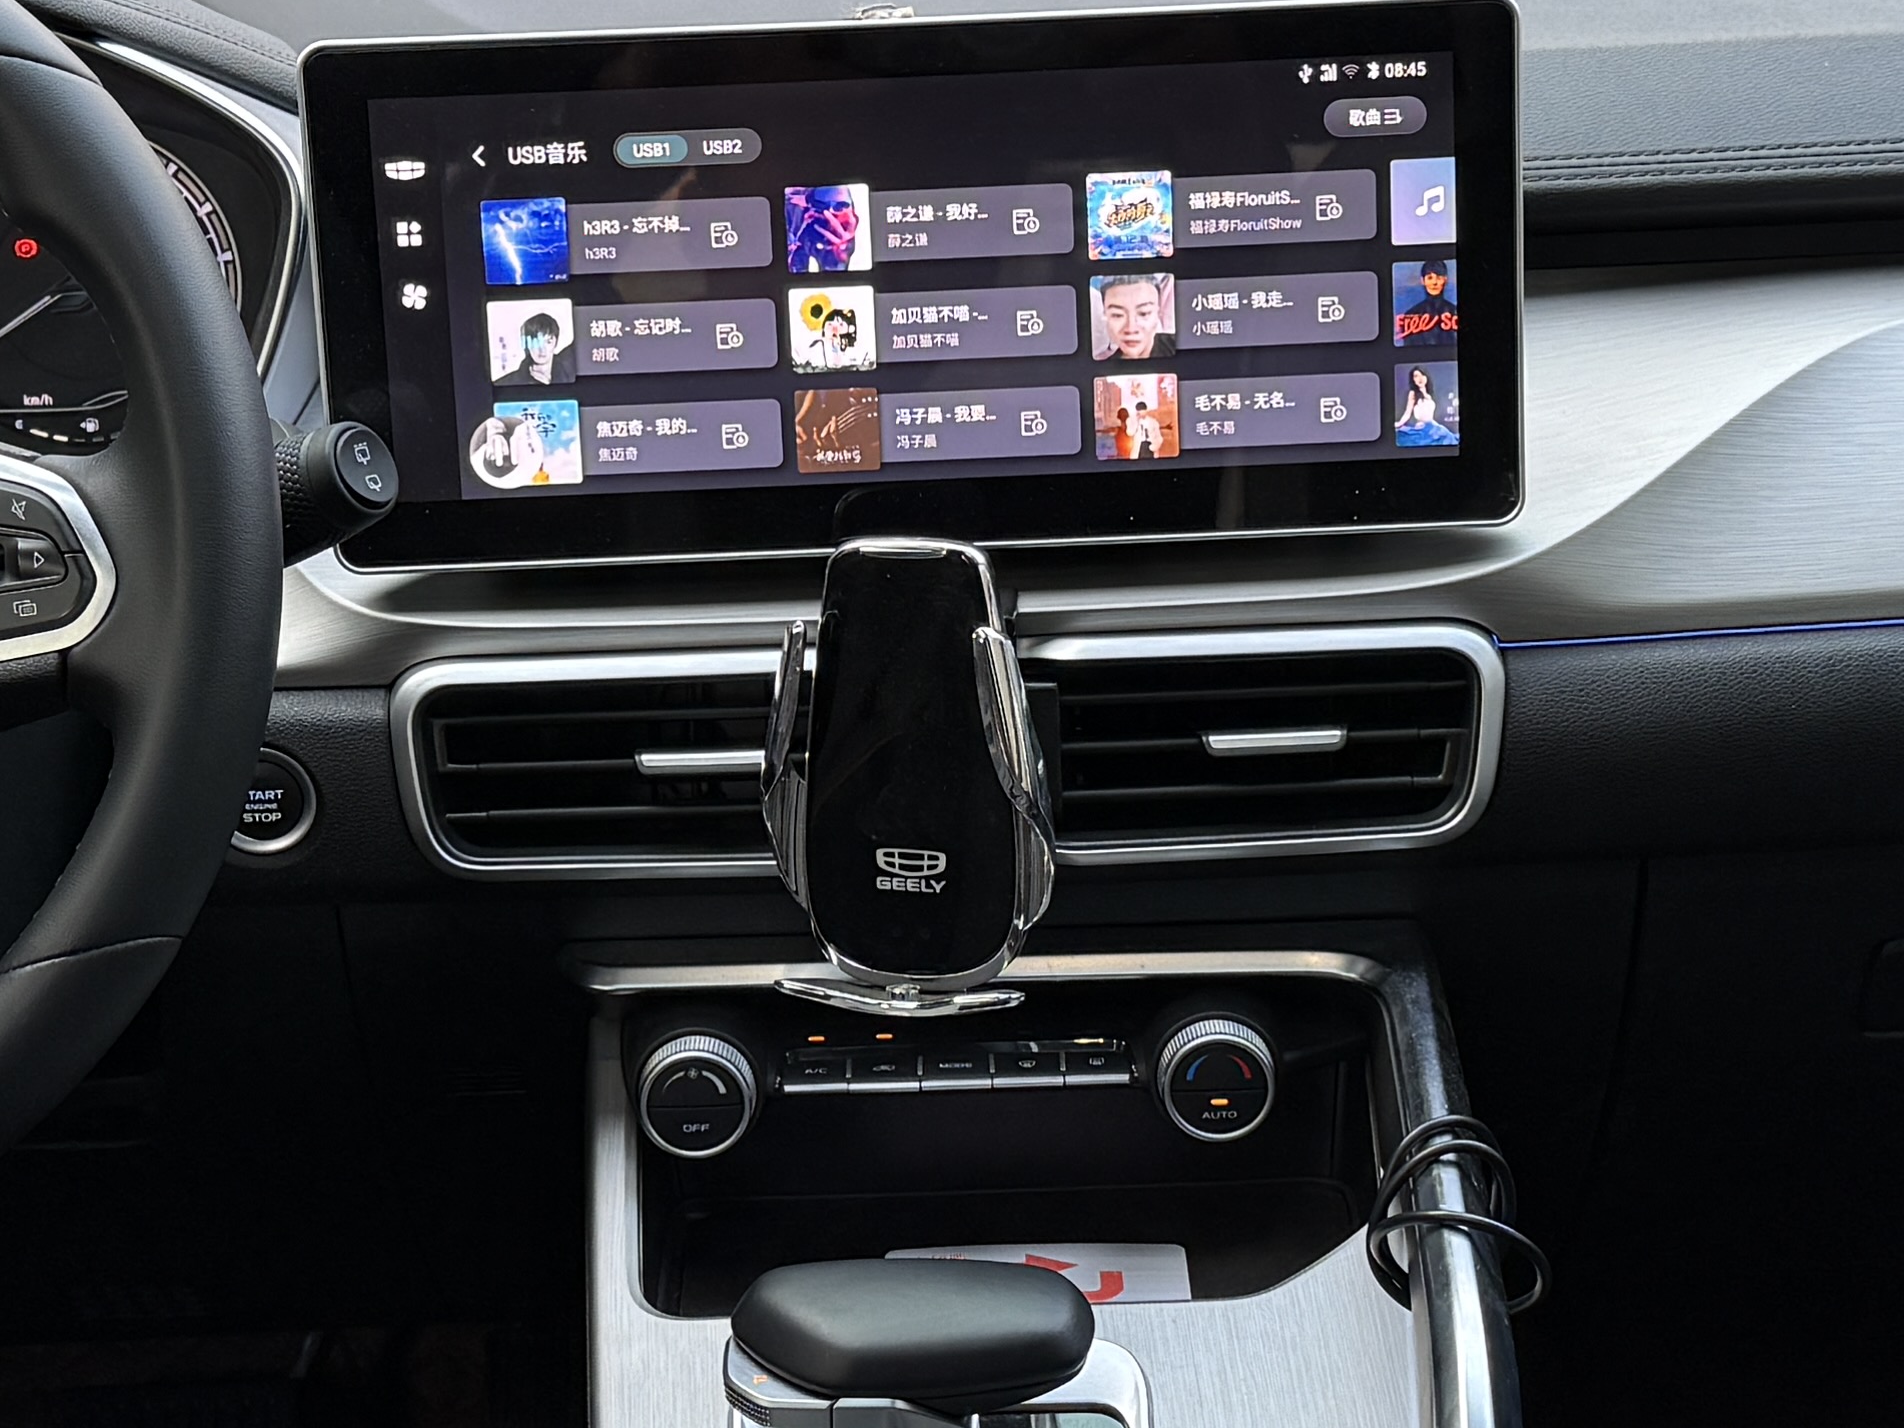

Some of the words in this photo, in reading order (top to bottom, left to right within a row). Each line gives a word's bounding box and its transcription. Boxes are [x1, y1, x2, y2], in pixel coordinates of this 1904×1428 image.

[1384, 61, 1427, 78] 08:45
[1348, 108, 1381, 127] 歌曲
[507, 141, 588, 165] USB音乐
[633, 142, 671, 158] USB1
[702, 139, 742, 155] USB2
[886, 205, 934, 224] 薛之谦
[583, 220, 621, 236] h3R3
[1190, 216, 1302, 235] 福禄寿FloruitShow
[887, 232, 928, 248] 薛之谦
[585, 247, 617, 260] h3R3
[1191, 292, 1239, 311] 小瑶瑶
[891, 305, 970, 325] 加贝猫不喵
[590, 320, 623, 338] 胡歌
[1193, 320, 1233, 336] 小瑶瑶
[892, 332, 960, 349] 加贝猫不喵
[592, 347, 619, 362] 胡歌
[23, 394, 53, 406] km/h
[1195, 393, 1240, 412] 毛不易
[895, 407, 943, 425] 冯子晨
[596, 420, 643, 438] 焦迈奇
[1196, 420, 1235, 435] 毛不易
[897, 434, 937, 449] 冯子晨
[598, 447, 638, 462] 焦迈奇
[248, 790, 284, 801] TART
[242, 812, 282, 823] STOP
[876, 876, 946, 893] GEELY
[1202, 1111, 1238, 1119] AUTO
[682, 1123, 710, 1132] OFF
